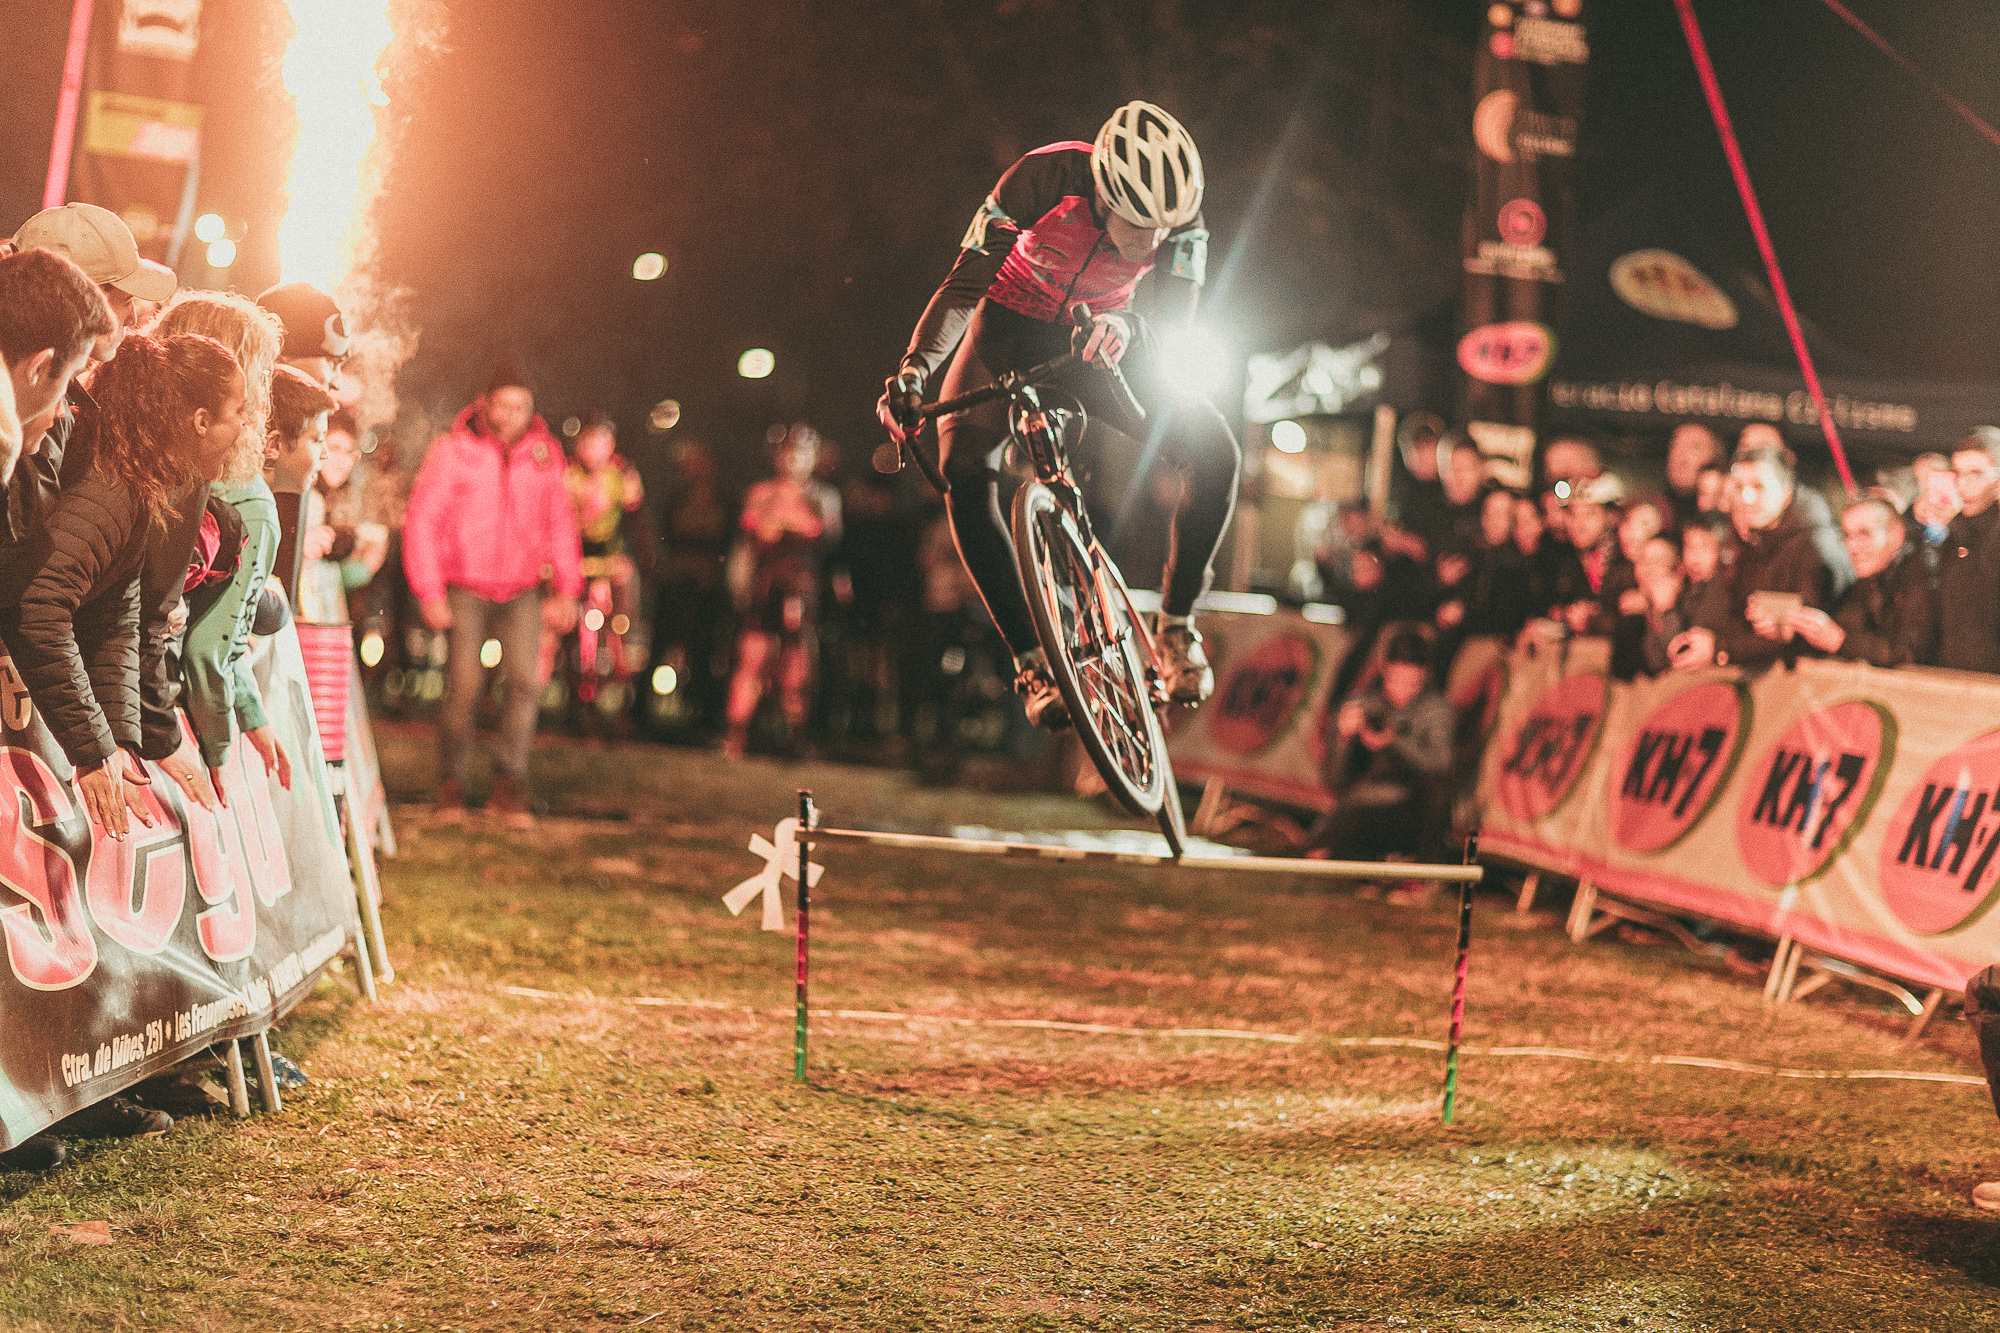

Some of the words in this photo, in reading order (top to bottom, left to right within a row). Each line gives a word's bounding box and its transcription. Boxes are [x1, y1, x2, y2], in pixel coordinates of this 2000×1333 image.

[61, 1053, 93, 1088] Ctra.
[93, 1042, 112, 1077] de
[145, 1018, 164, 1057] 251
[174, 1010, 192, 1043] Les
